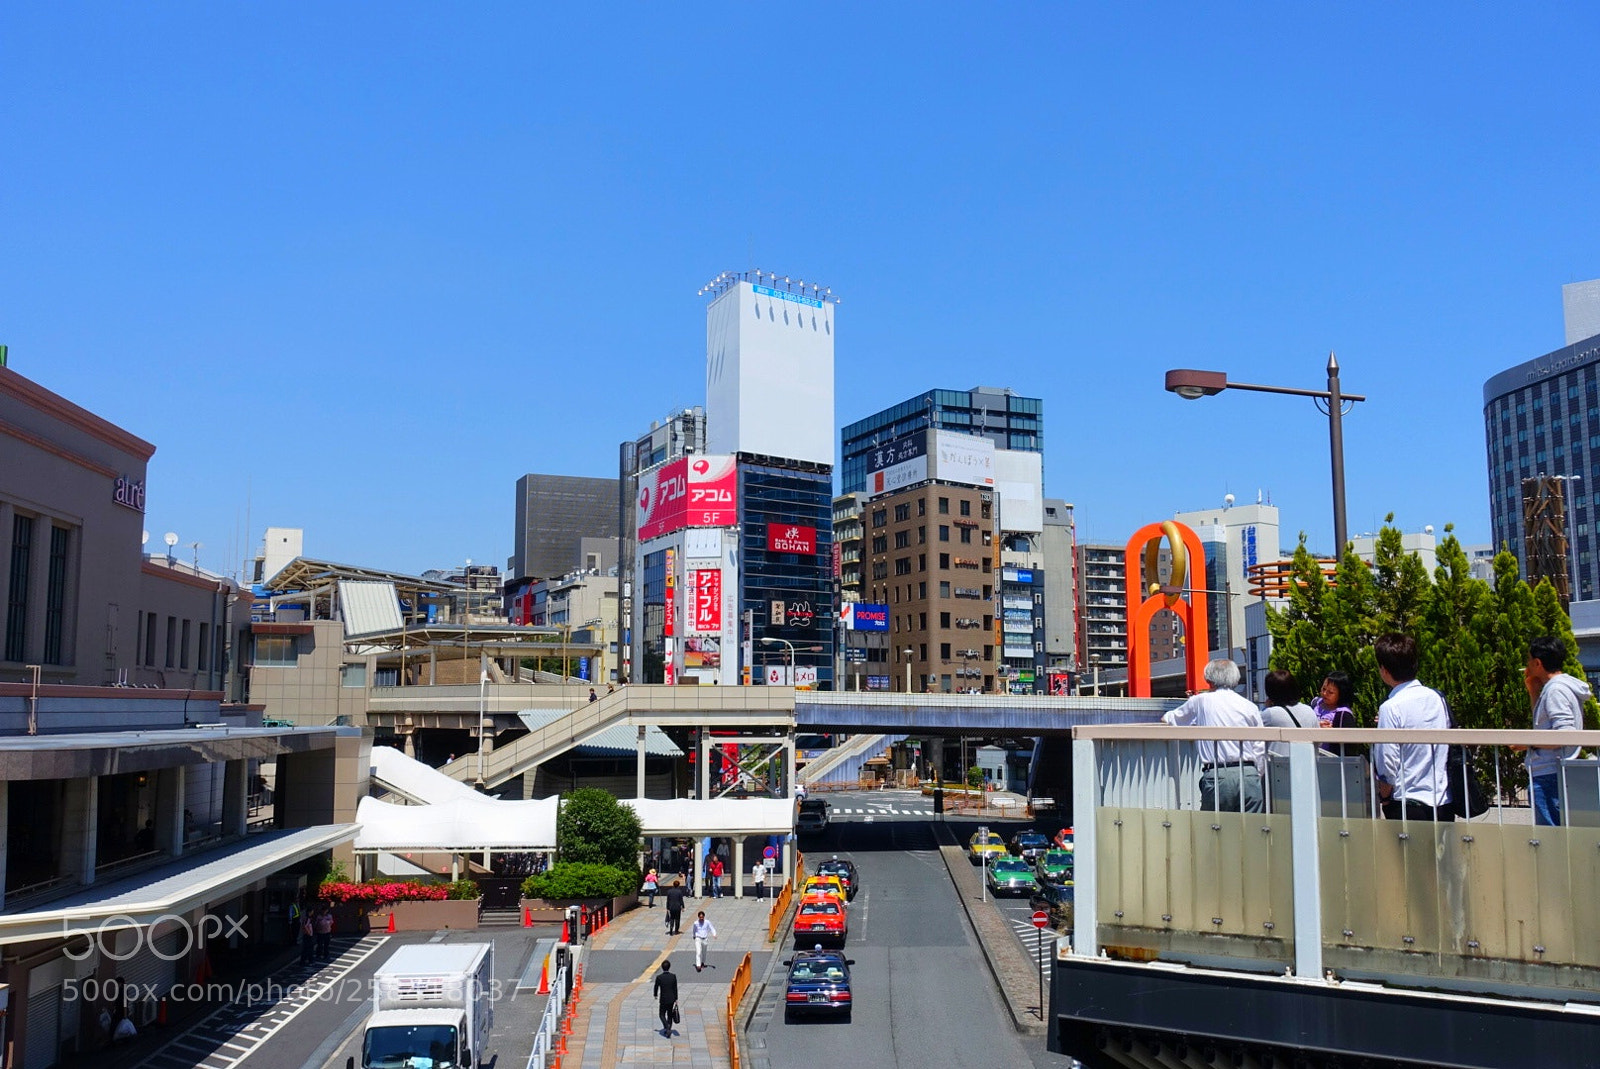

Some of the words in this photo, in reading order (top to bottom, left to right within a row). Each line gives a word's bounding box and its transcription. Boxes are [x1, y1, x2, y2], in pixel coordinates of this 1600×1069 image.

[874, 447, 896, 468] 漢方
[660, 474, 686, 505] アコム
[691, 489, 732, 502] アコム
[703, 512, 720, 523] 5F
[774, 542, 810, 552] GOHAN
[699, 571, 712, 621] アイフル
[856, 611, 886, 621] PROMISE
